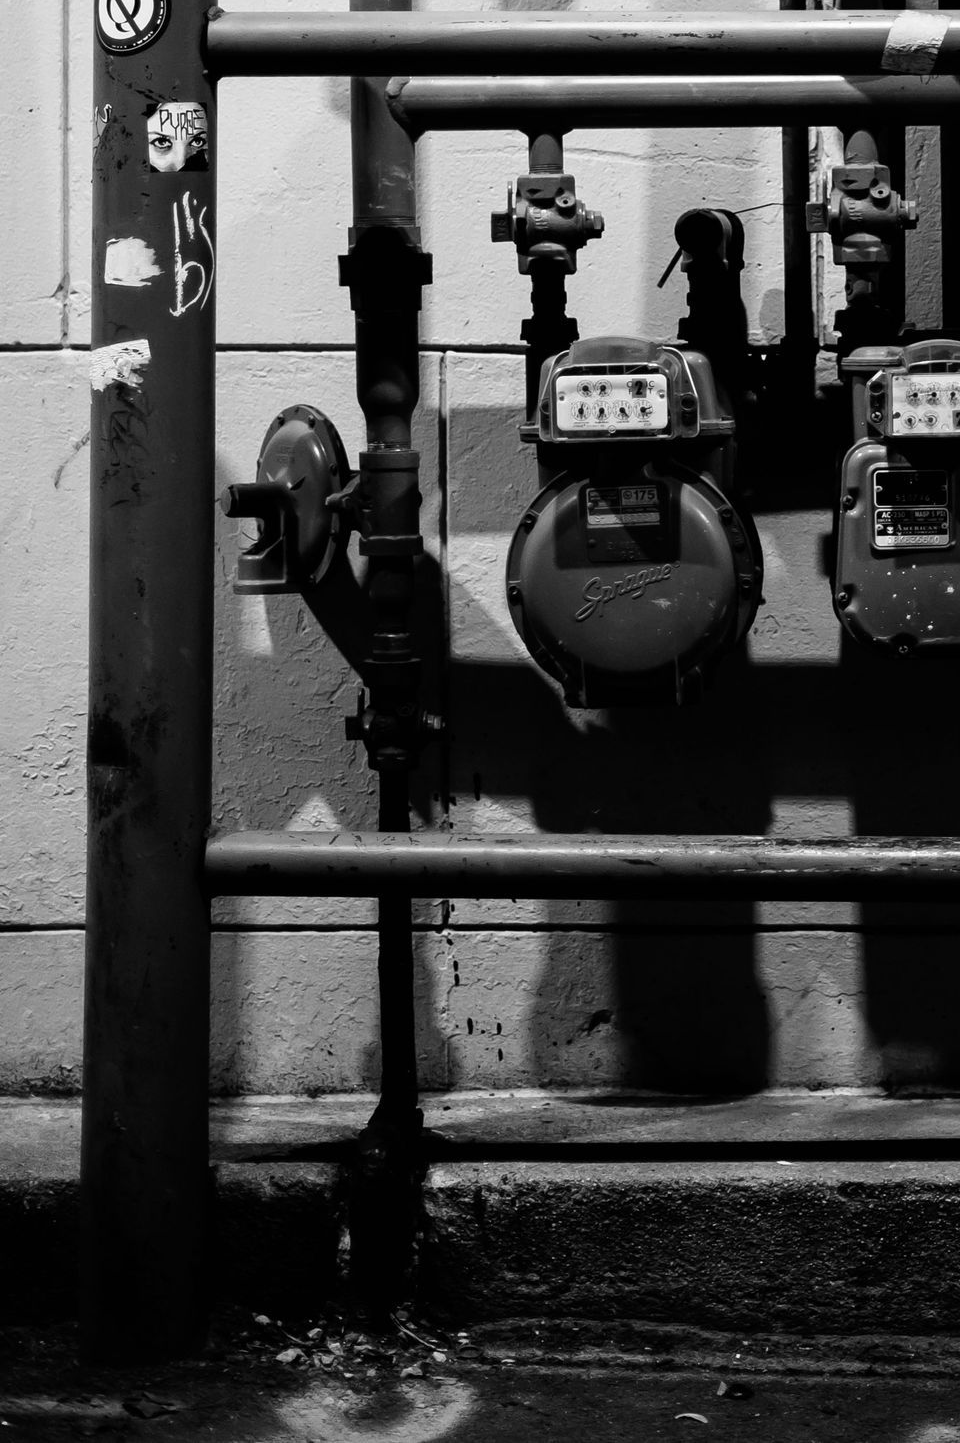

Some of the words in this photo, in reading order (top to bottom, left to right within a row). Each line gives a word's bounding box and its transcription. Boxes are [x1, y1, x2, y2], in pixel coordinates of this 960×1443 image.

[634, 380, 644, 396] 2
[634, 490, 655, 500] 175
[575, 563, 672, 623] Sprague
